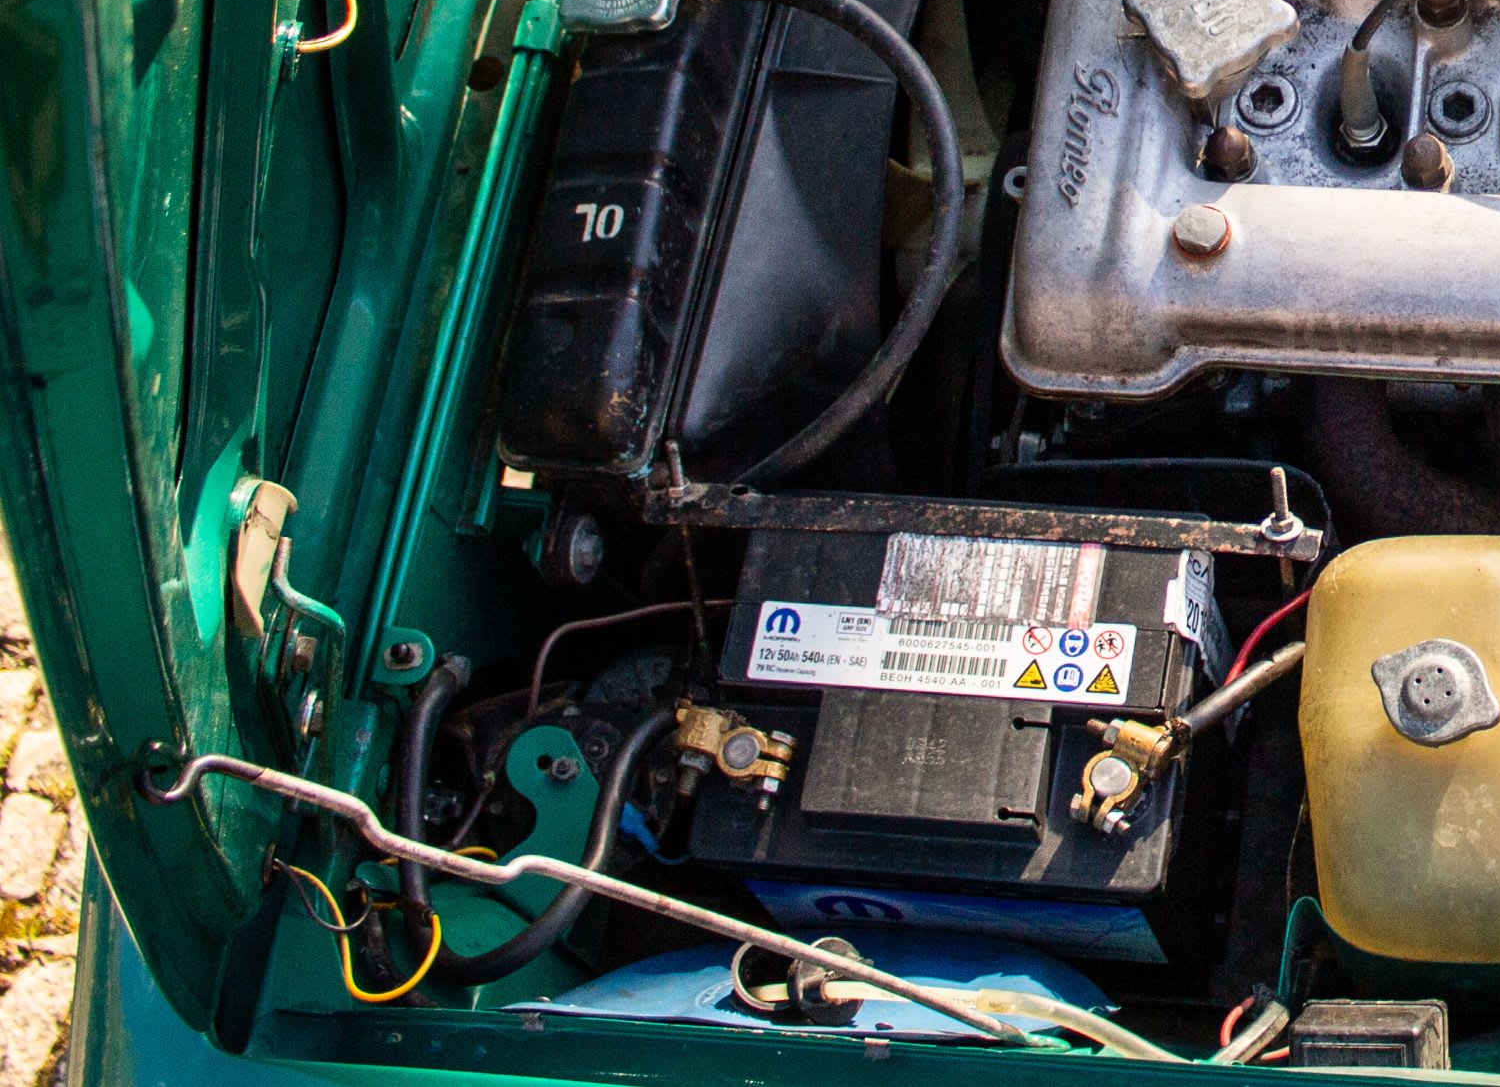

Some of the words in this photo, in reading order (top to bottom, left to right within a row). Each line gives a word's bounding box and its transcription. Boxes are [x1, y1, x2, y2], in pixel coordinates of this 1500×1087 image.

[1059, 61, 1121, 208] Romeo
[576, 203, 624, 242] 70
[898, 638, 996, 653] 6000627545-001
[778, 649, 799, 662] 50Ah
[802, 651, 825, 664] 540A
[848, 656, 868, 667] SAE)
[917, 674, 945, 685] 4540
[950, 676, 967, 686] AA
[981, 679, 1001, 689] 001
